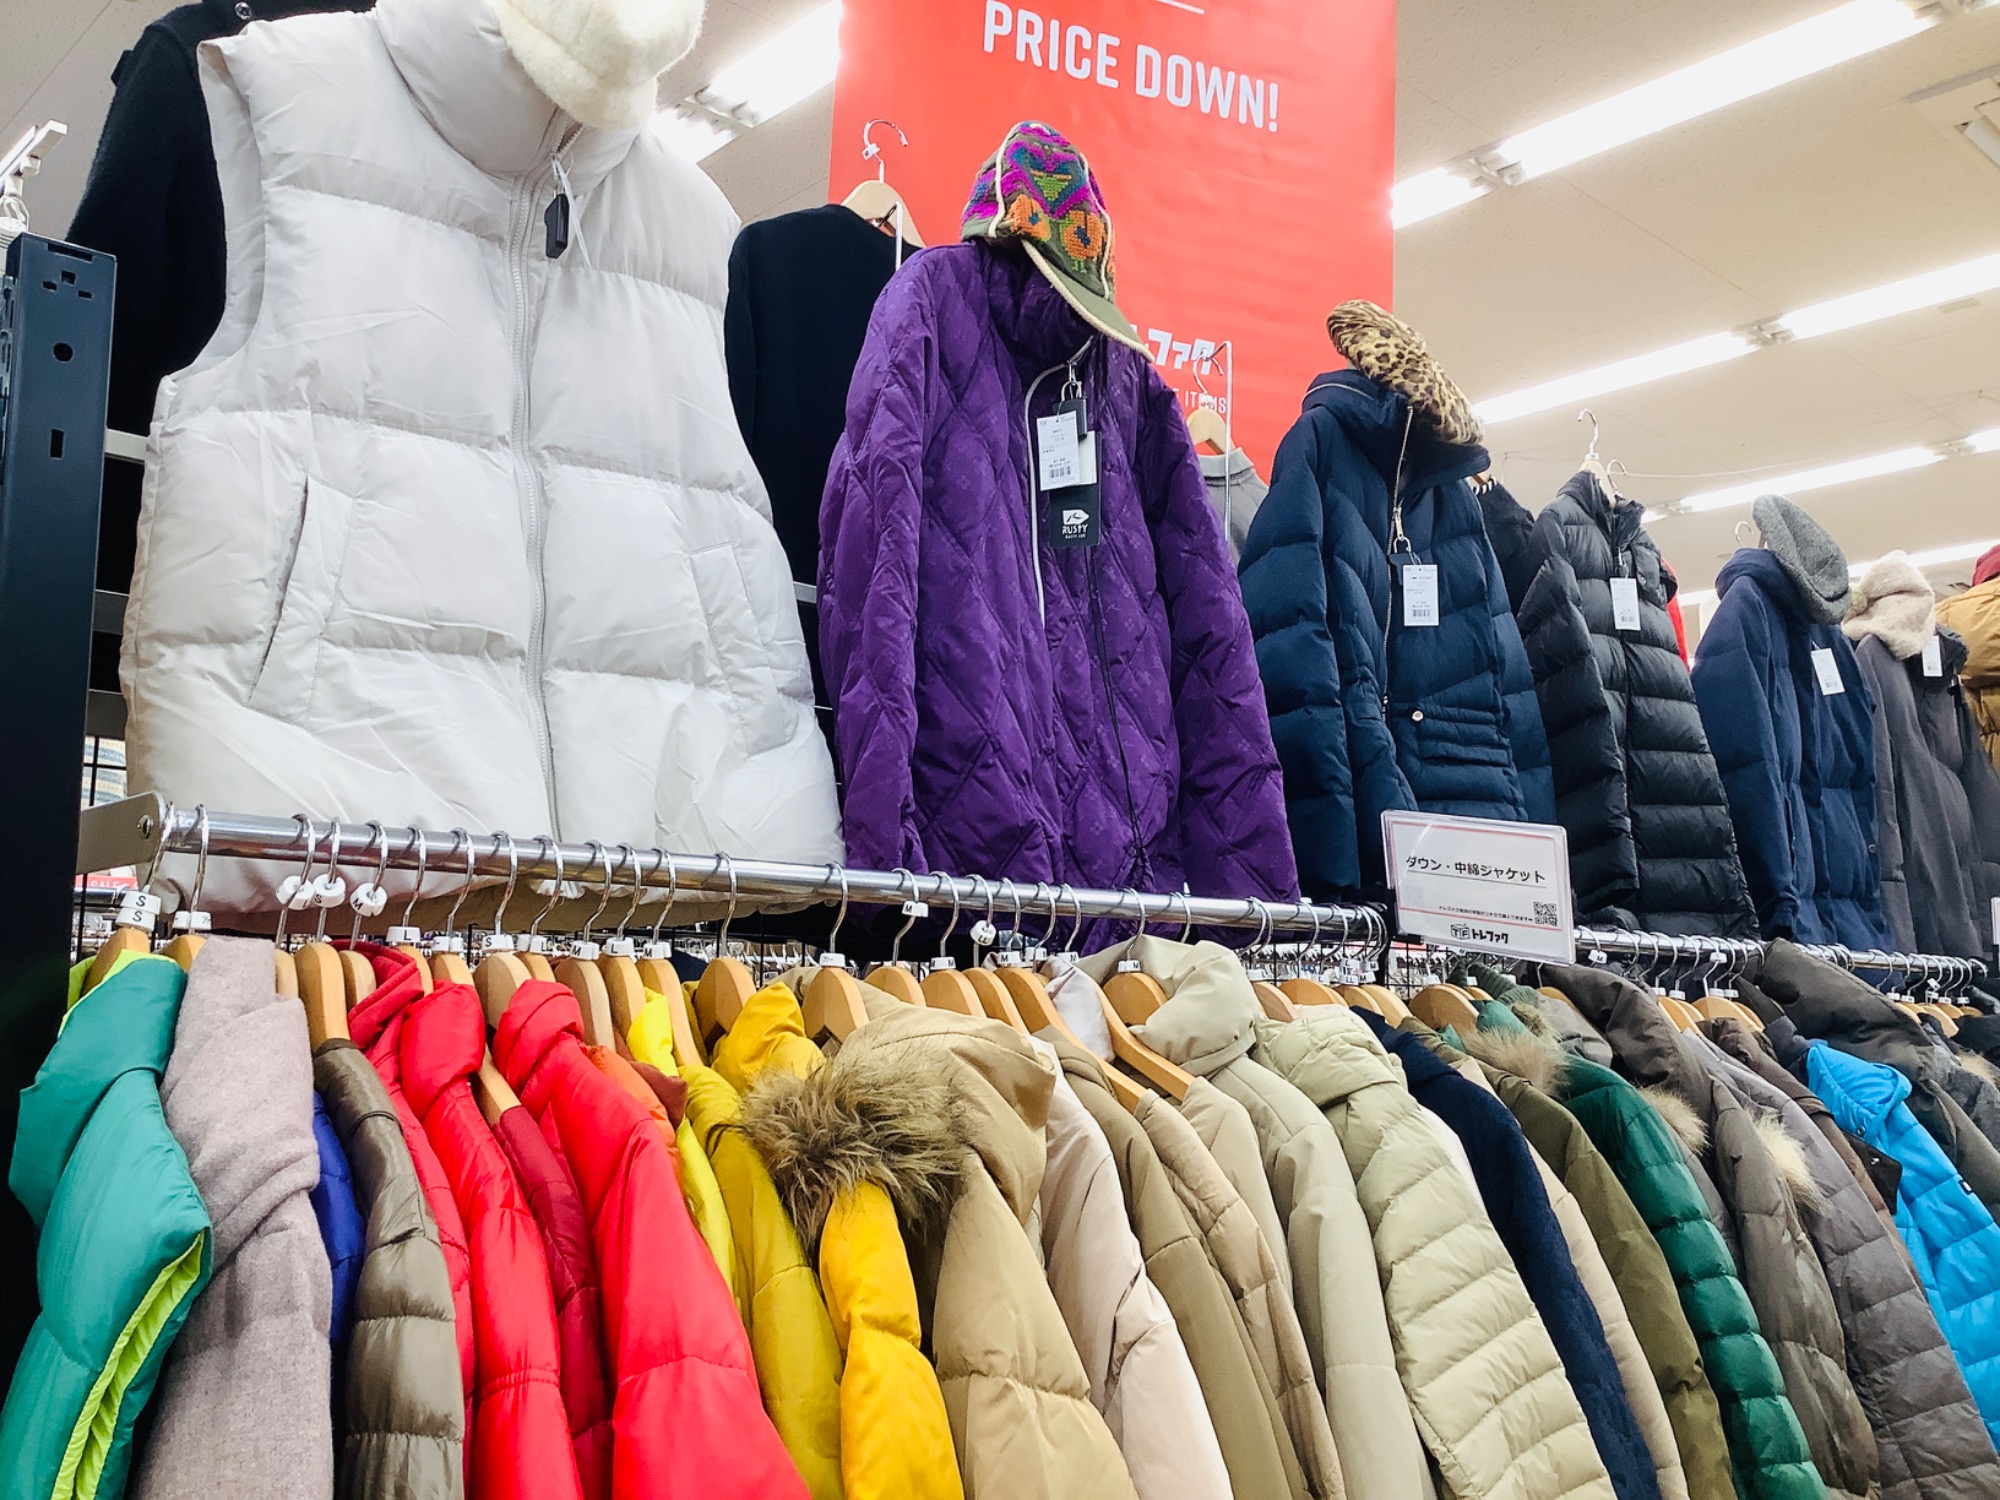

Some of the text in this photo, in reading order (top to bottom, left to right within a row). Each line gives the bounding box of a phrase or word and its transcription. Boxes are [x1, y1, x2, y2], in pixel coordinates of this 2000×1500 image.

[983, 0, 1279, 133] PRICE DOWN!
[1131, 324, 1216, 376] ファク
[1061, 524, 1088, 534] RUSTY
[1405, 855, 1546, 884] ダウン・中綿ジャケット
[135, 895, 147, 907] S
[316, 894, 324, 904] S
[352, 897, 364, 911] M
[904, 904, 913, 914] M
[132, 910, 143, 923] S
[403, 929, 412, 941] L
[976, 934, 988, 945] LL
[1471, 928, 1509, 945] トレファク
[485, 936, 493, 948] S
[571, 945, 582, 957] M
[610, 943, 619, 954] L
[643, 948, 653, 958] M
[947, 959, 955, 968] M
[1000, 952, 1009, 963] M
[1132, 961, 1140, 969] M
